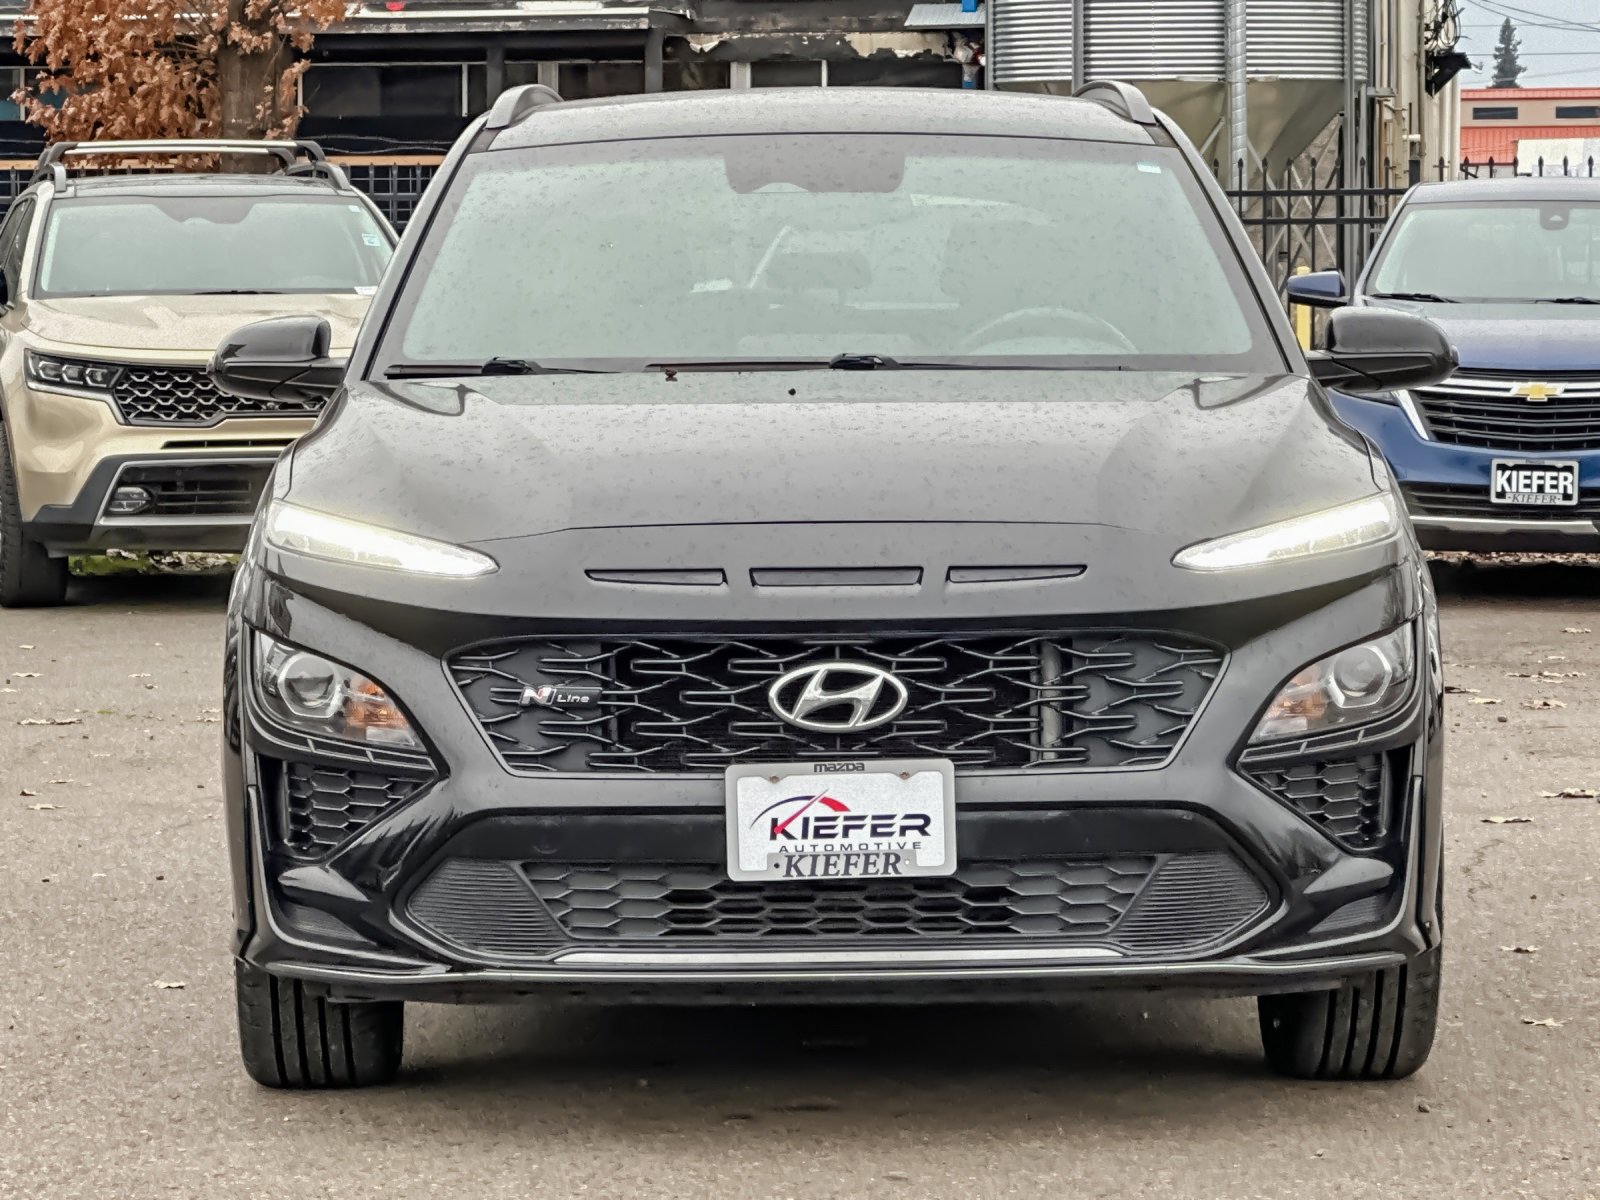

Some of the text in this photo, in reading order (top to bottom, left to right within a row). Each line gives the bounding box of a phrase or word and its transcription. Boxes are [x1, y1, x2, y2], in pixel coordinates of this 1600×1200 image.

[1496, 470, 1573, 494] KIEFER
[1511, 493, 1557, 504] KIEFER
[521, 686, 590, 705] N Line
[769, 813, 932, 841] KIEFER
[778, 841, 922, 853] AUTOMOTIVE
[782, 851, 903, 878] KIEFER
